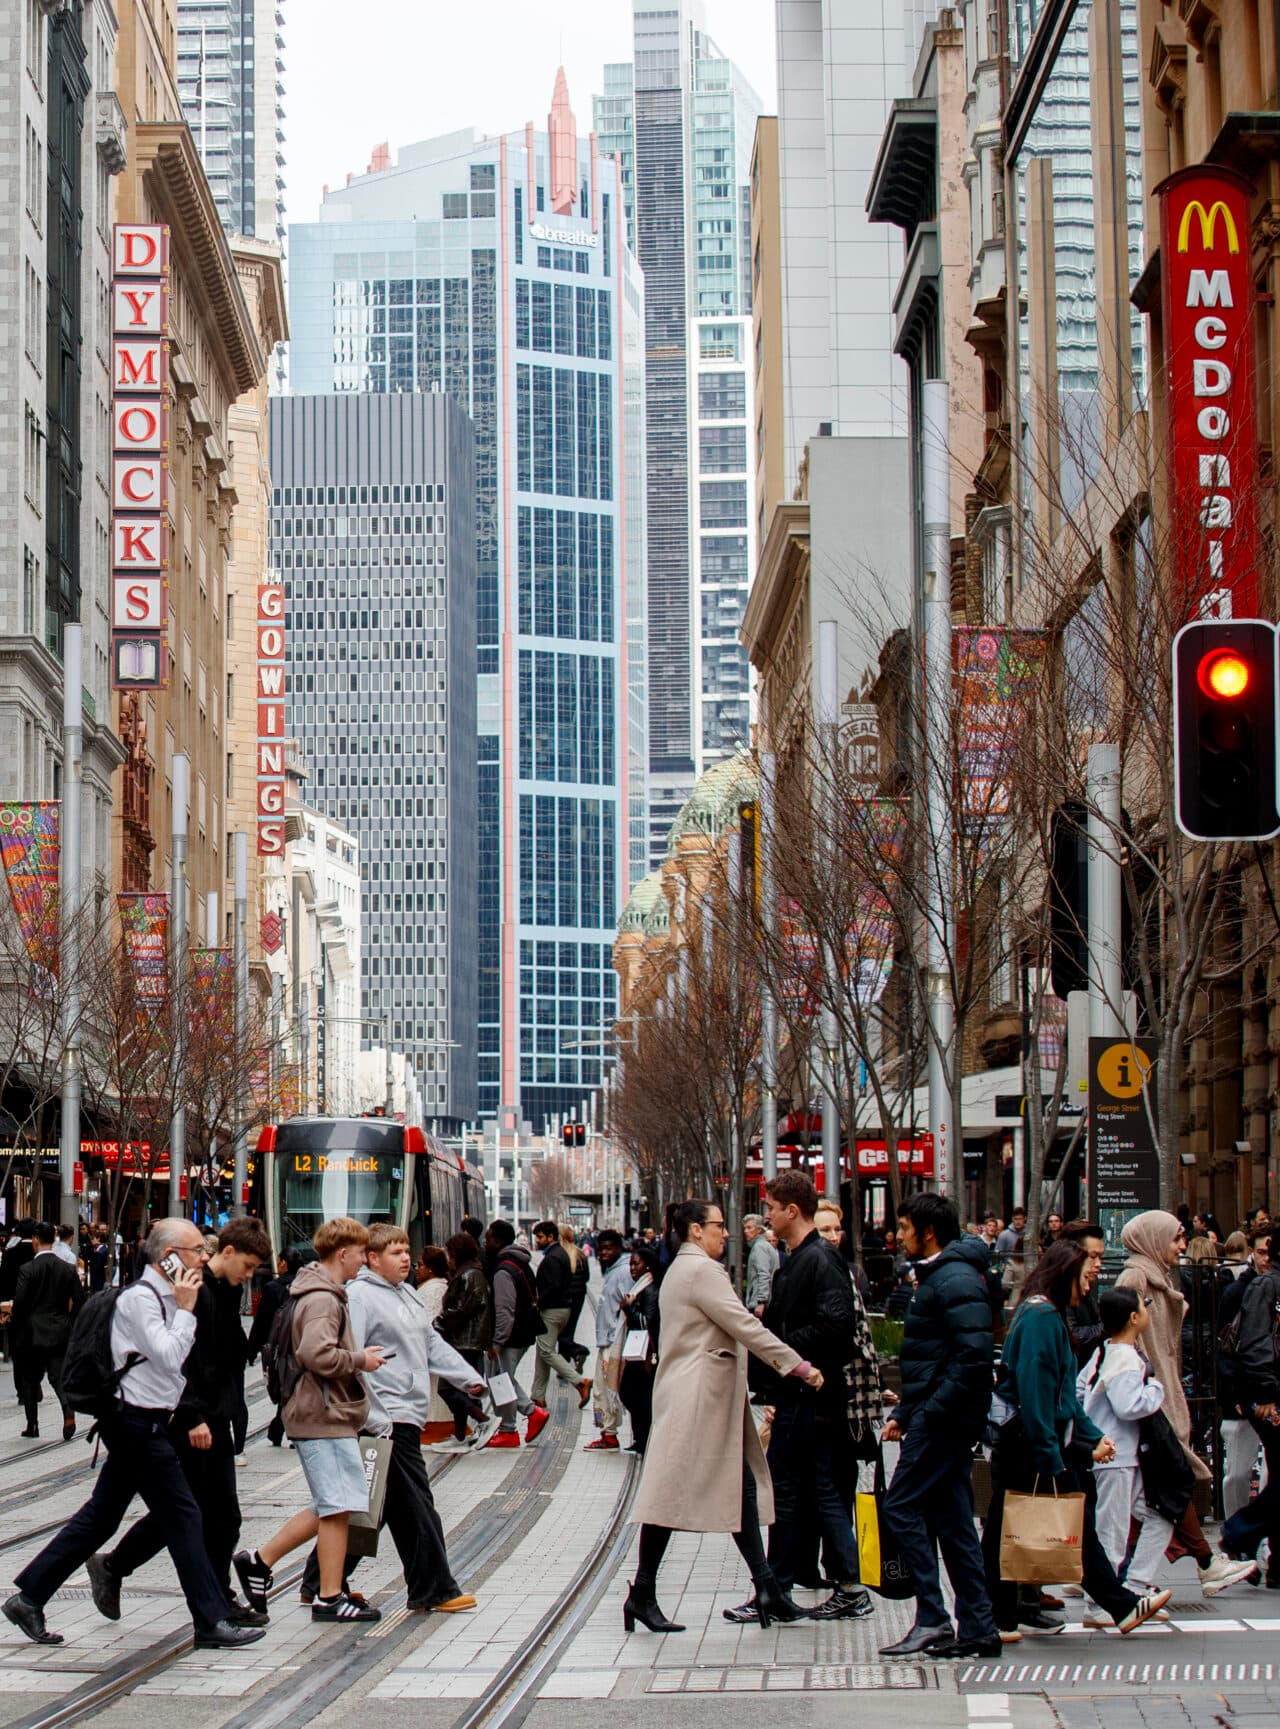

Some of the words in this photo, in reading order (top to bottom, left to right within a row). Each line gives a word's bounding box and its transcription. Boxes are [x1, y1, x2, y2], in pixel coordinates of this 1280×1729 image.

[118, 233, 158, 620] DYMOCKS
[260, 589, 283, 853] GOWINGS
[1096, 1104, 1120, 1113] George
[1121, 1104, 1140, 1112] Street
[1097, 1113, 1109, 1121] King
[80, 1142, 132, 1153] DYMOCS
[295, 1156, 312, 1172] L2
[318, 1156, 378, 1172] Randwick
